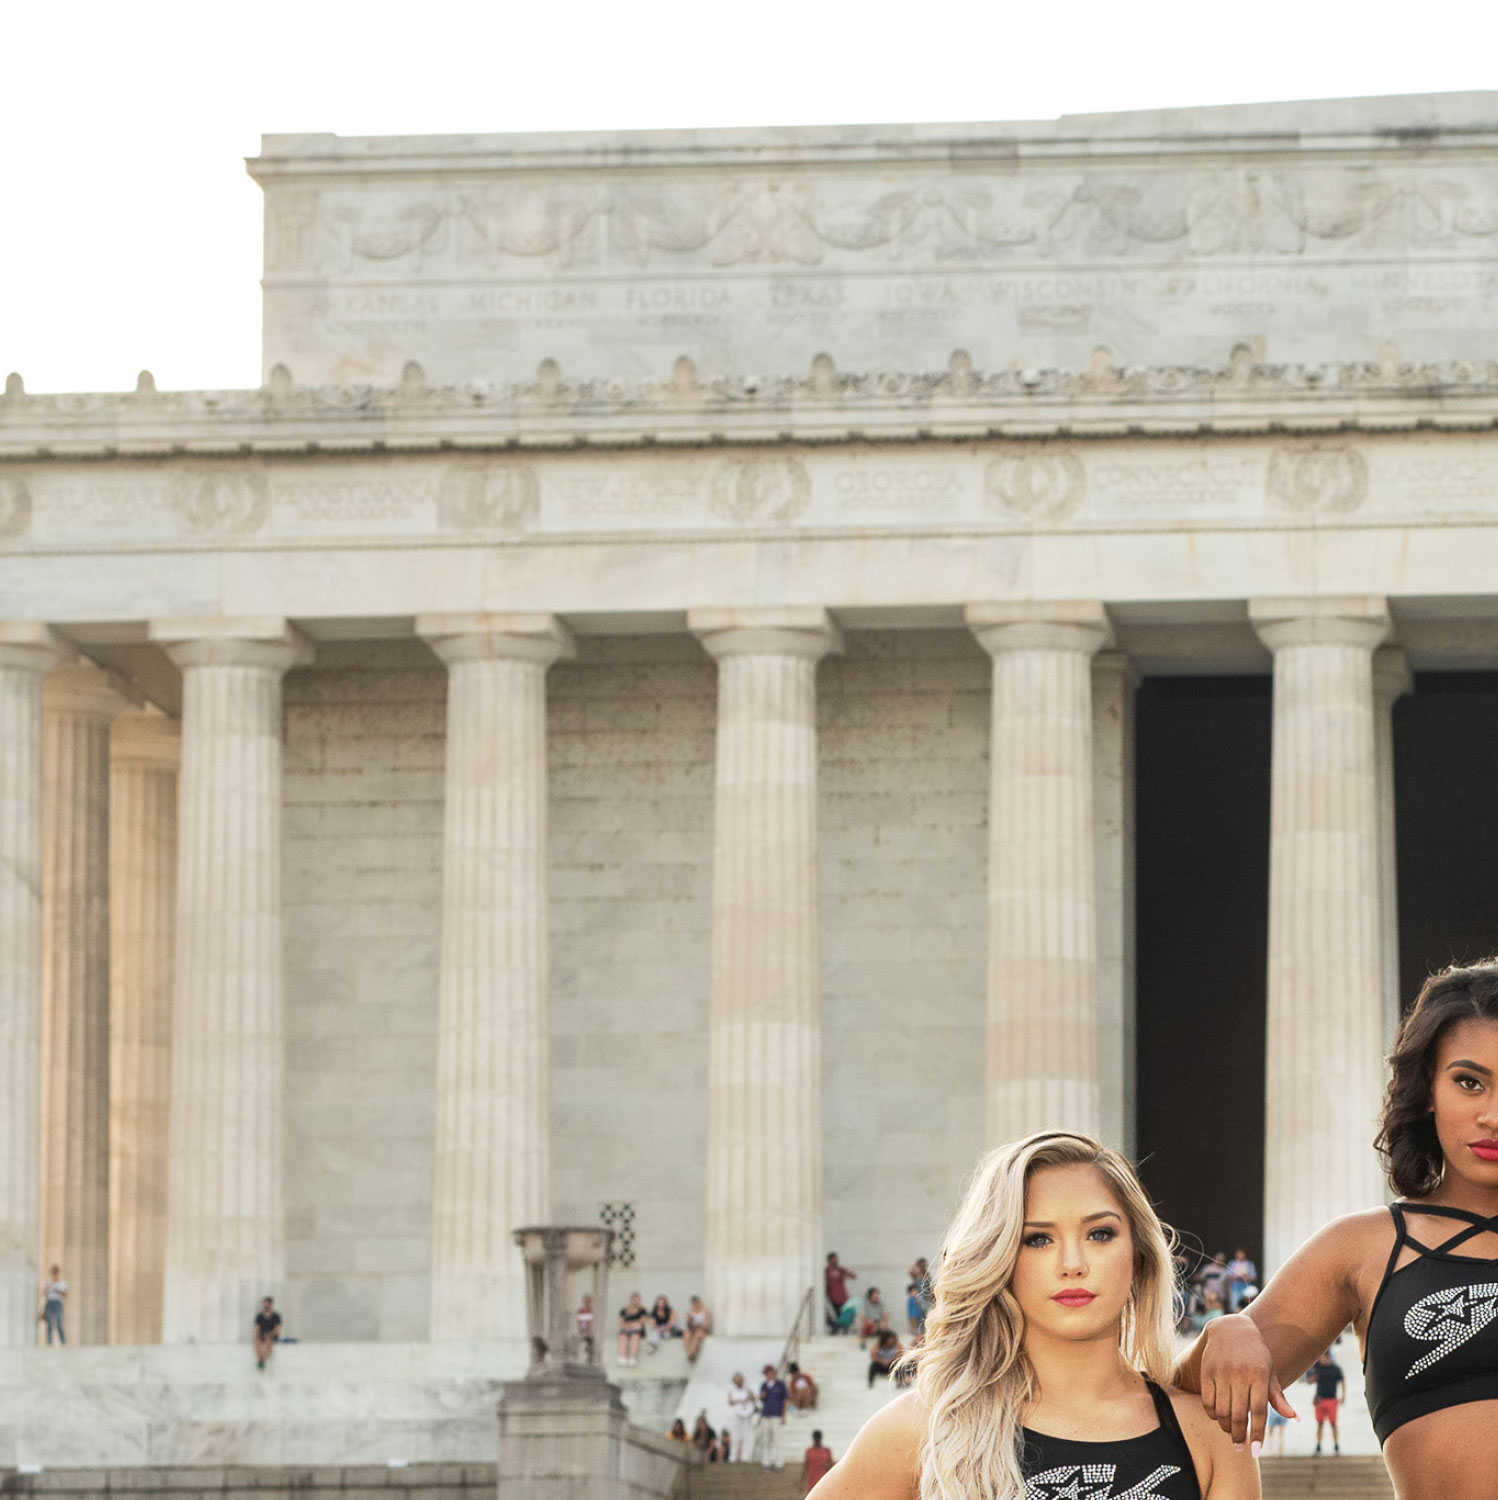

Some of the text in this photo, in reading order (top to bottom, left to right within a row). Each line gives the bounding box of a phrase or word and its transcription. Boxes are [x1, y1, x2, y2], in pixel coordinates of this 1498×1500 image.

[468, 289, 597, 313] MICHIGAN
[625, 286, 731, 309] FLORIDA
[883, 282, 957, 304] IOWA
